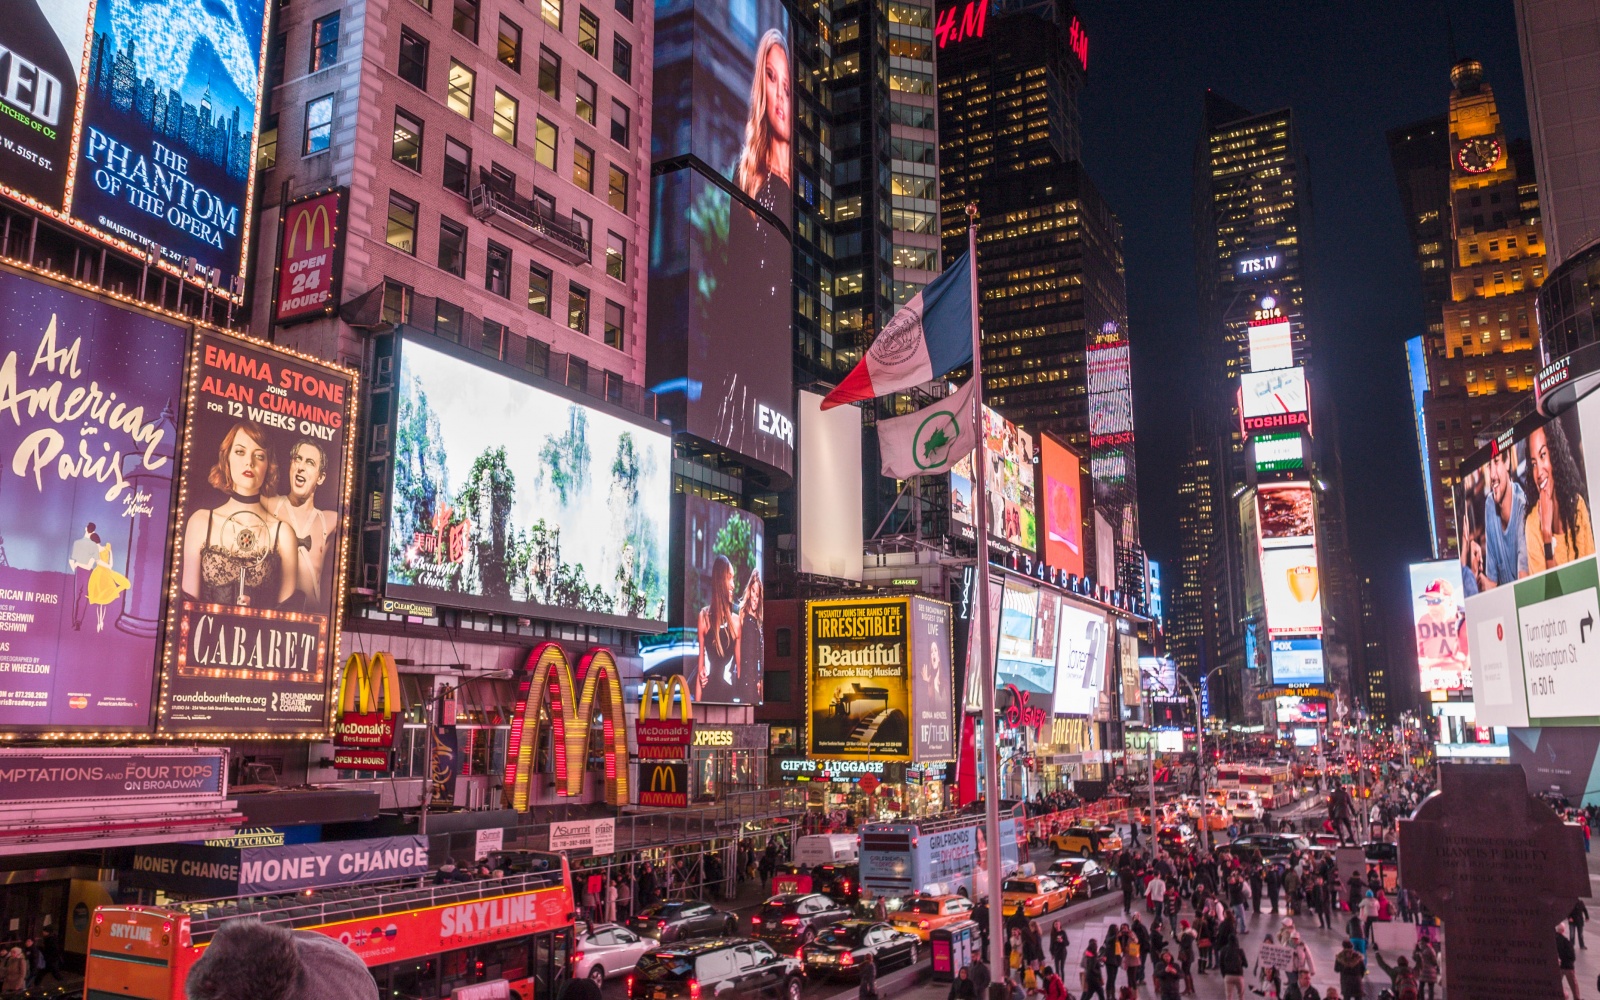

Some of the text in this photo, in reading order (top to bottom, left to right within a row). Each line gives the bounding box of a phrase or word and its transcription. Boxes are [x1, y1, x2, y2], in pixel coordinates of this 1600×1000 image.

[936, 0, 988, 48] H&M
[0, 45, 61, 126] ED
[0, 101, 57, 140] ITCHES OF OZ
[16, 145, 38, 163] 51ST
[39, 157, 53, 171] ST.
[153, 140, 188, 175] THE
[86, 126, 238, 236] PHANTOM
[95, 169, 223, 250] OF THE OPERA
[106, 219, 138, 240] MAJESTIC
[289, 254, 326, 274] OPEN
[291, 269, 320, 295] 24
[281, 290, 328, 311] HOURS
[1249, 316, 1289, 327] TOSHIBA
[1255, 309, 1281, 320] 2014
[29, 313, 81, 379] An
[204, 344, 344, 405] EMMA STONE
[1540, 356, 1571, 381] MARRIOTT
[266, 384, 288, 397] JOINS
[1540, 370, 1567, 392] MARQUIS
[0, 351, 167, 470] American
[200, 375, 342, 429] ALAN CUMMING
[80, 421, 98, 436] in
[207, 400, 336, 442] FOR 12 WEEKS ONLY
[1245, 412, 1308, 429] TOSHIBA
[12, 428, 131, 501] Paris
[25, 592, 34, 602] IN
[35, 593, 58, 604] PARIS
[857, 608, 866, 617] THE
[884, 606, 891, 616] OF
[891, 606, 900, 616] THE
[927, 623, 939, 636] LIVE
[1525, 618, 1568, 643] Turn right on
[193, 614, 316, 672] CABARET
[1273, 641, 1292, 651] FOX
[818, 642, 901, 666] Beautiful
[1528, 648, 1568, 671] Washington
[1568, 643, 1578, 663] St
[11, 663, 50, 674] WHEELDON
[818, 667, 901, 678] The Carole King Musical
[1531, 675, 1555, 696] in 50 ft
[172, 691, 324, 707] roundabouttheatre.org ROUNDABOUT
[335, 722, 391, 736] McDonald's
[638, 727, 689, 735] McDonald's
[693, 730, 733, 745] XPRESS
[920, 723, 950, 745] IF/THEN
[1051, 718, 1082, 746] FOREVER
[343, 736, 381, 744] Restaurant
[335, 756, 352, 764] OPEN
[363, 757, 385, 765] HOURS
[781, 761, 884, 773] GIFTS LUGGAGE
[105, 772, 124, 780] AND
[125, 766, 169, 780] FOUR
[172, 765, 213, 779] TOPS
[124, 779, 204, 791] ON BROADWAY
[238, 833, 284, 846] EXCHANGE
[133, 855, 238, 882] MONEY CHANGE
[240, 846, 428, 885] MONEY CHANGE
[440, 893, 537, 938] SKYLINE
[110, 923, 153, 941] SKYLINE
[440, 922, 537, 947] SIGHTSEEING
